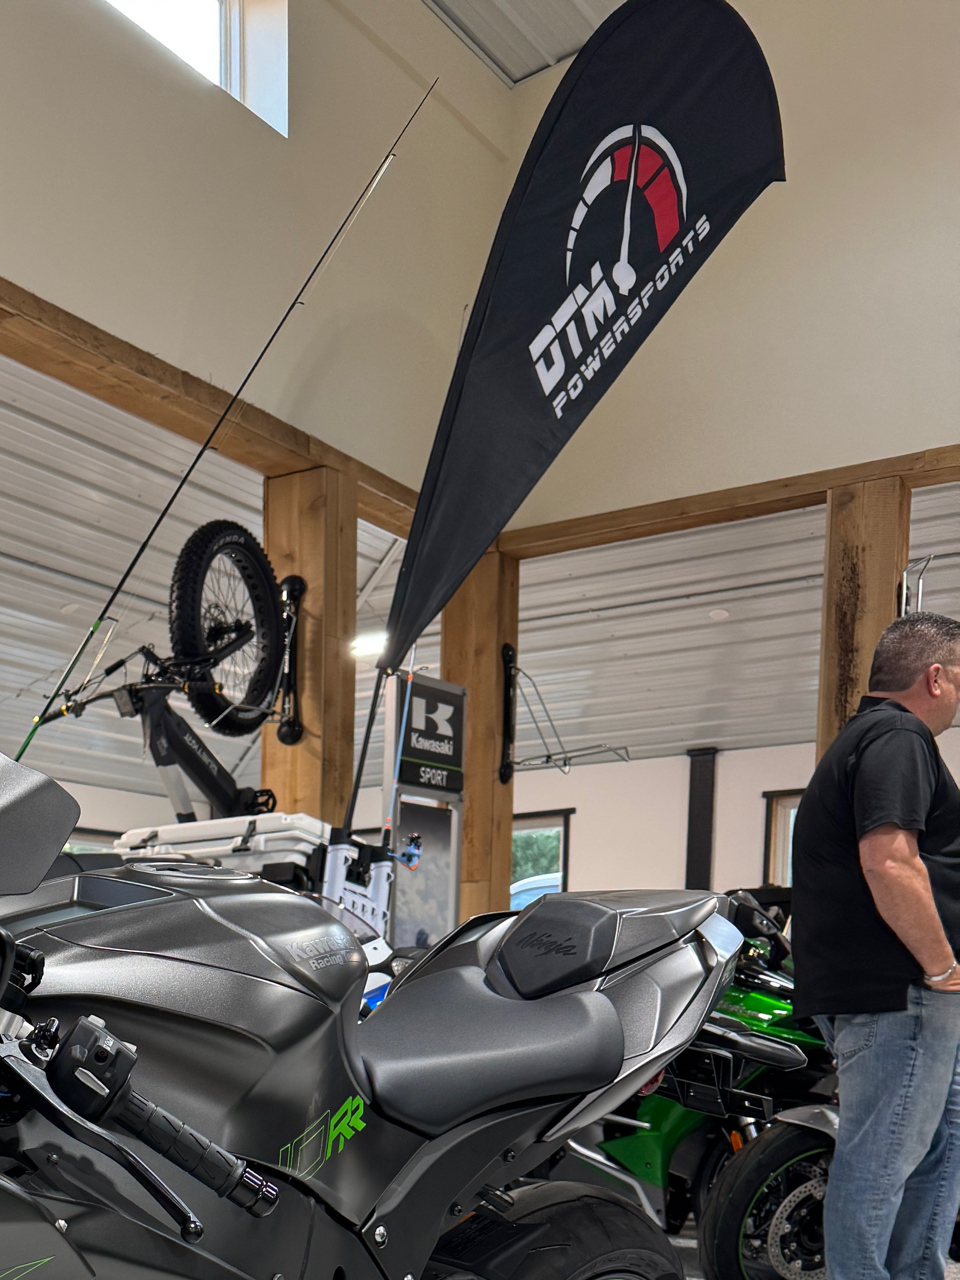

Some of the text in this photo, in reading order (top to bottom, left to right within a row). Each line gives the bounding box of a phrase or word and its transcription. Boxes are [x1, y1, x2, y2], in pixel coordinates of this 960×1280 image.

[528, 260, 617, 397] DTM
[552, 214, 711, 419] POWERSPORTS
[410, 731, 454, 756] Kawasaki
[419, 766, 448, 787] SPORT
[515, 932, 577, 958] Ninja
[308, 952, 345, 971] Racing
